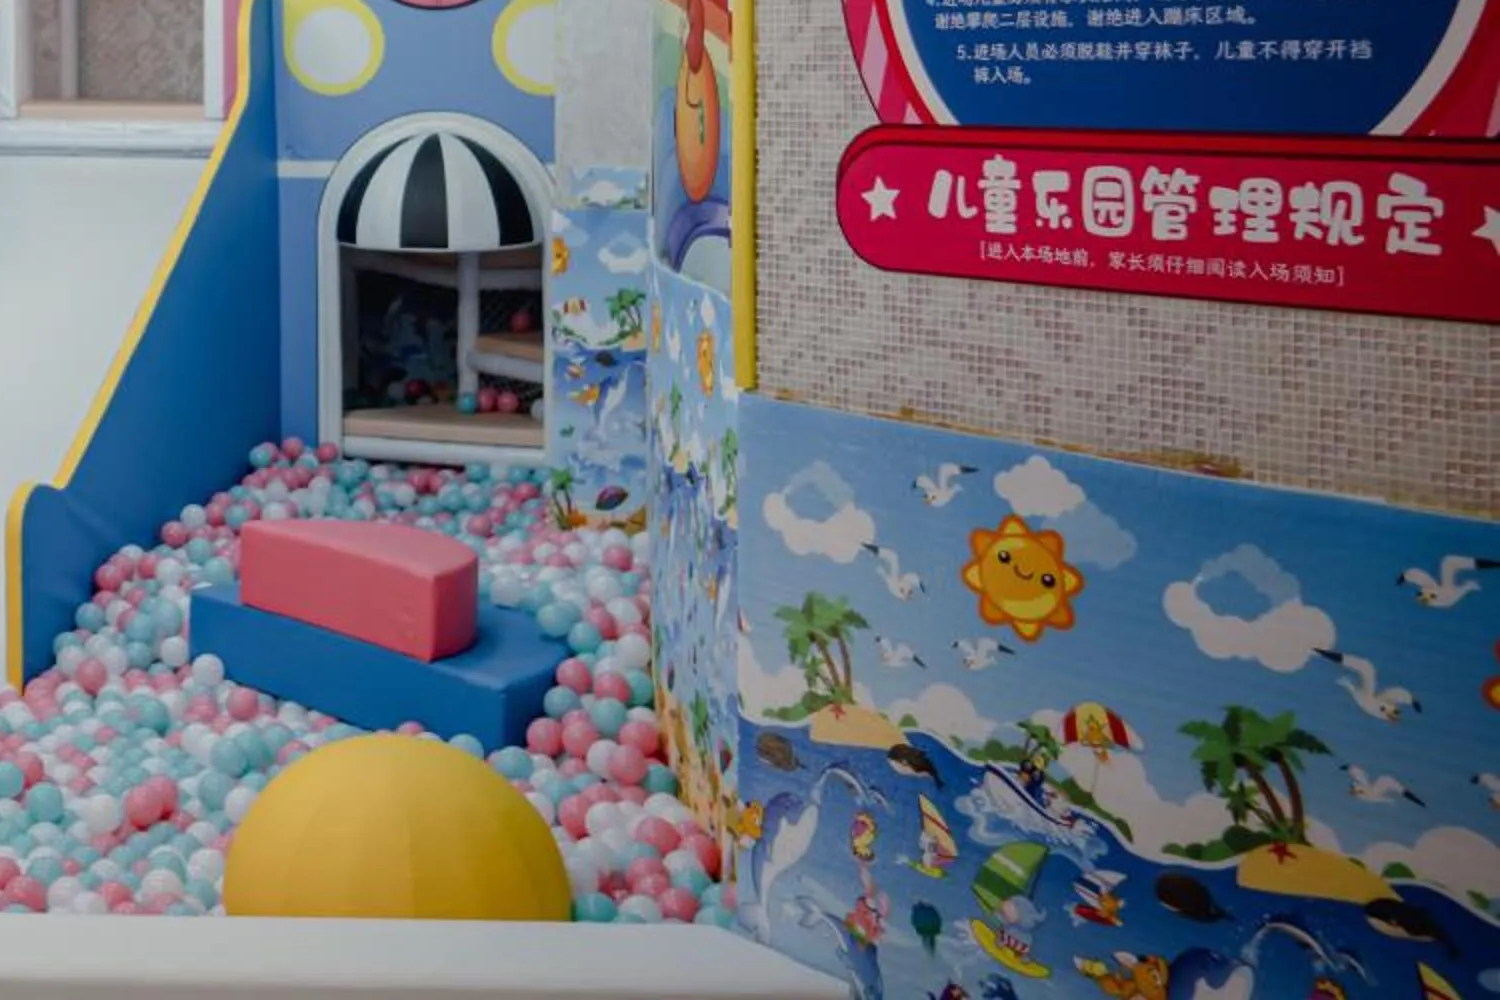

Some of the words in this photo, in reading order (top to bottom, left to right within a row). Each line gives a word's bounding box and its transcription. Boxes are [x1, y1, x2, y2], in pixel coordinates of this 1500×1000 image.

[927, 154, 1445, 256] 儿童乐园管理规定
